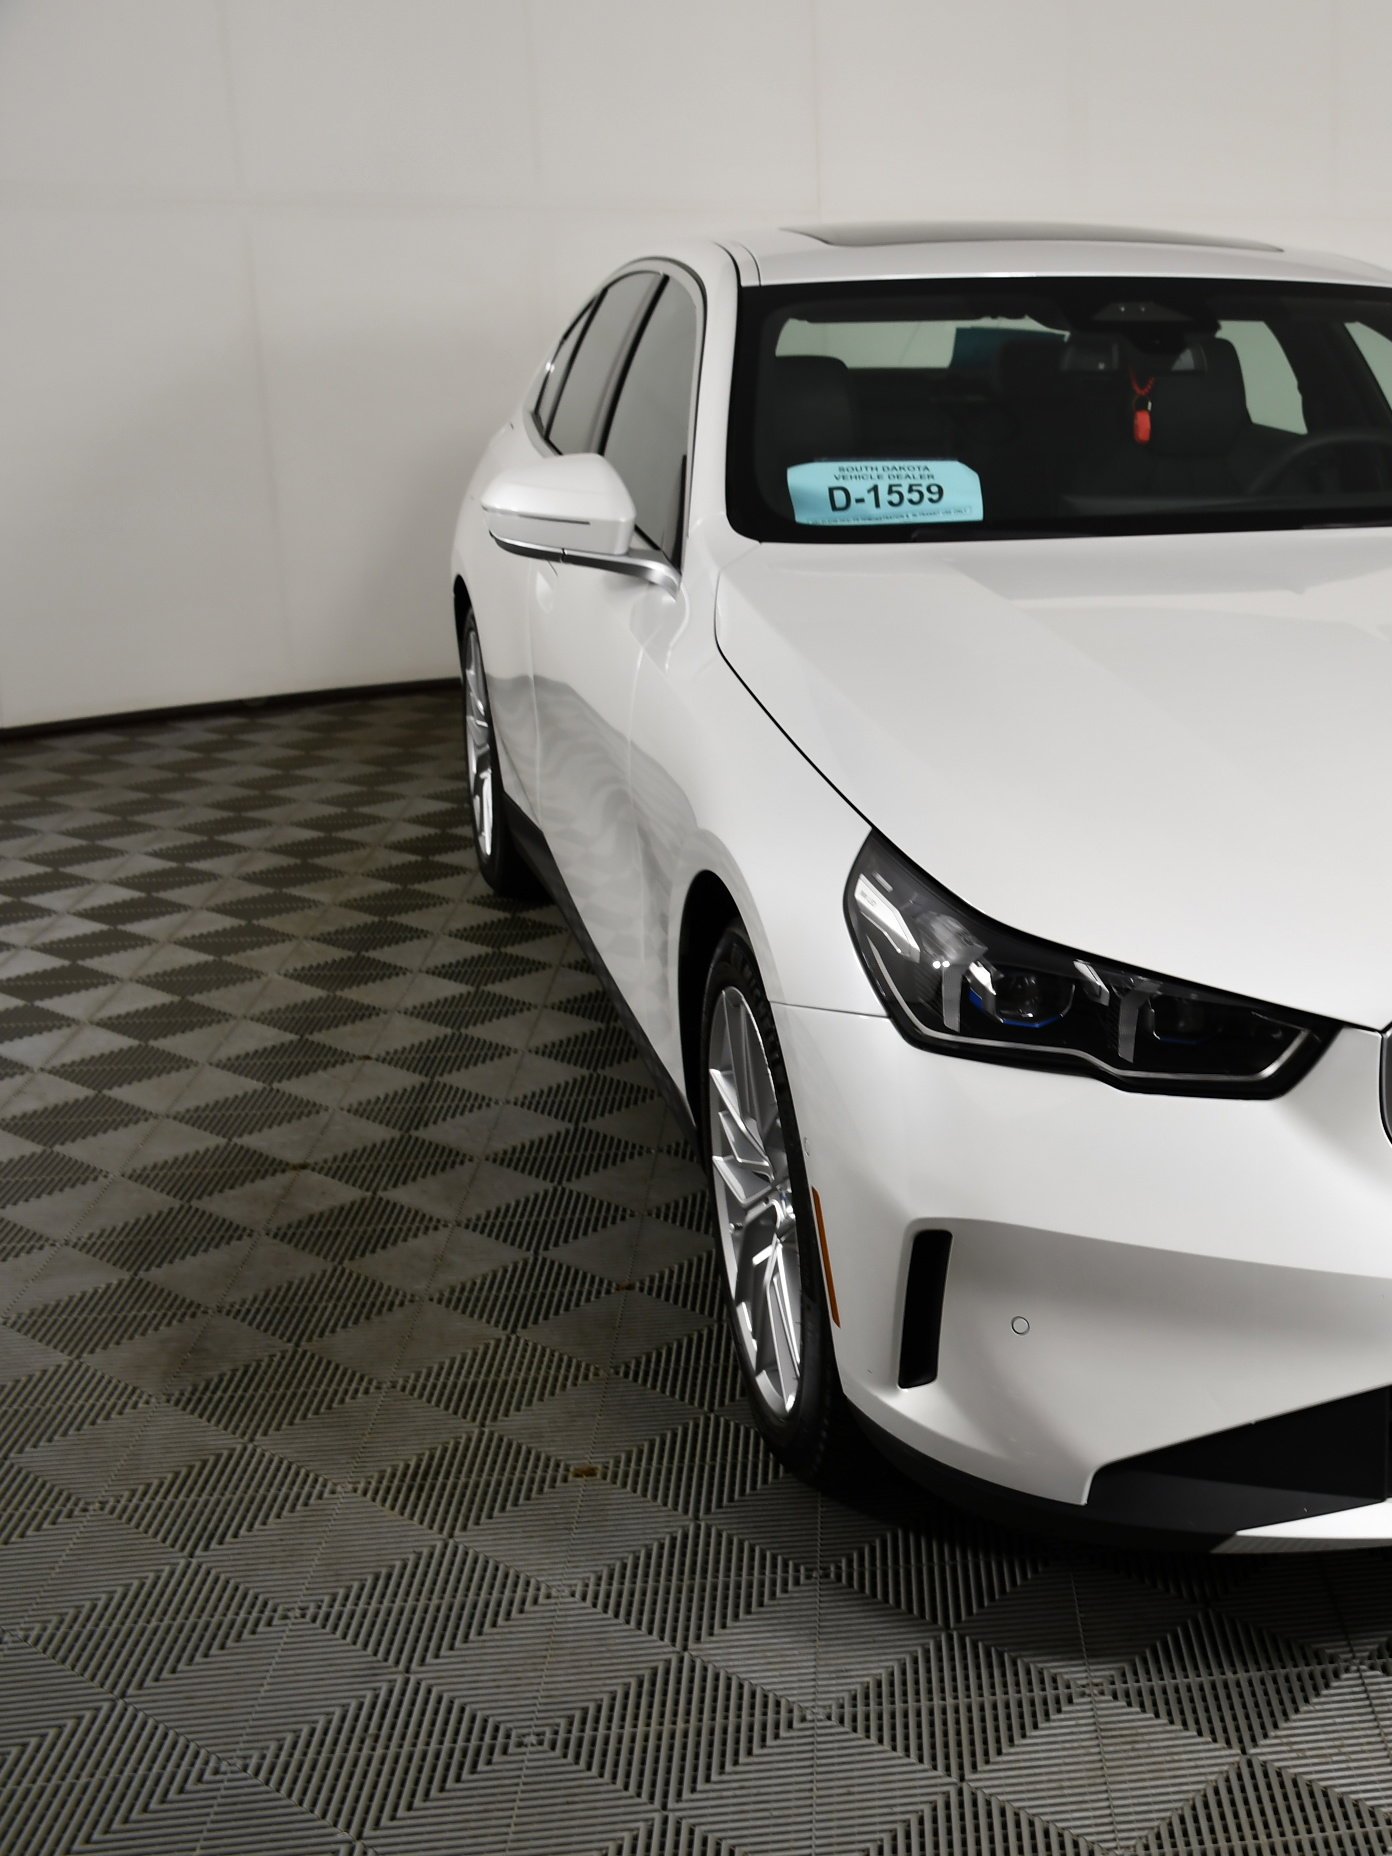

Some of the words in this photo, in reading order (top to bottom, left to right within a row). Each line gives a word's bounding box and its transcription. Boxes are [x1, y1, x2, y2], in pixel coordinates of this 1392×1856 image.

[838, 465, 879, 473] SOUTH
[881, 465, 930, 473] DAKOTA
[833, 473, 883, 481] VEHICLE
[887, 473, 935, 481] DEALER
[827, 483, 945, 512] D-1559
